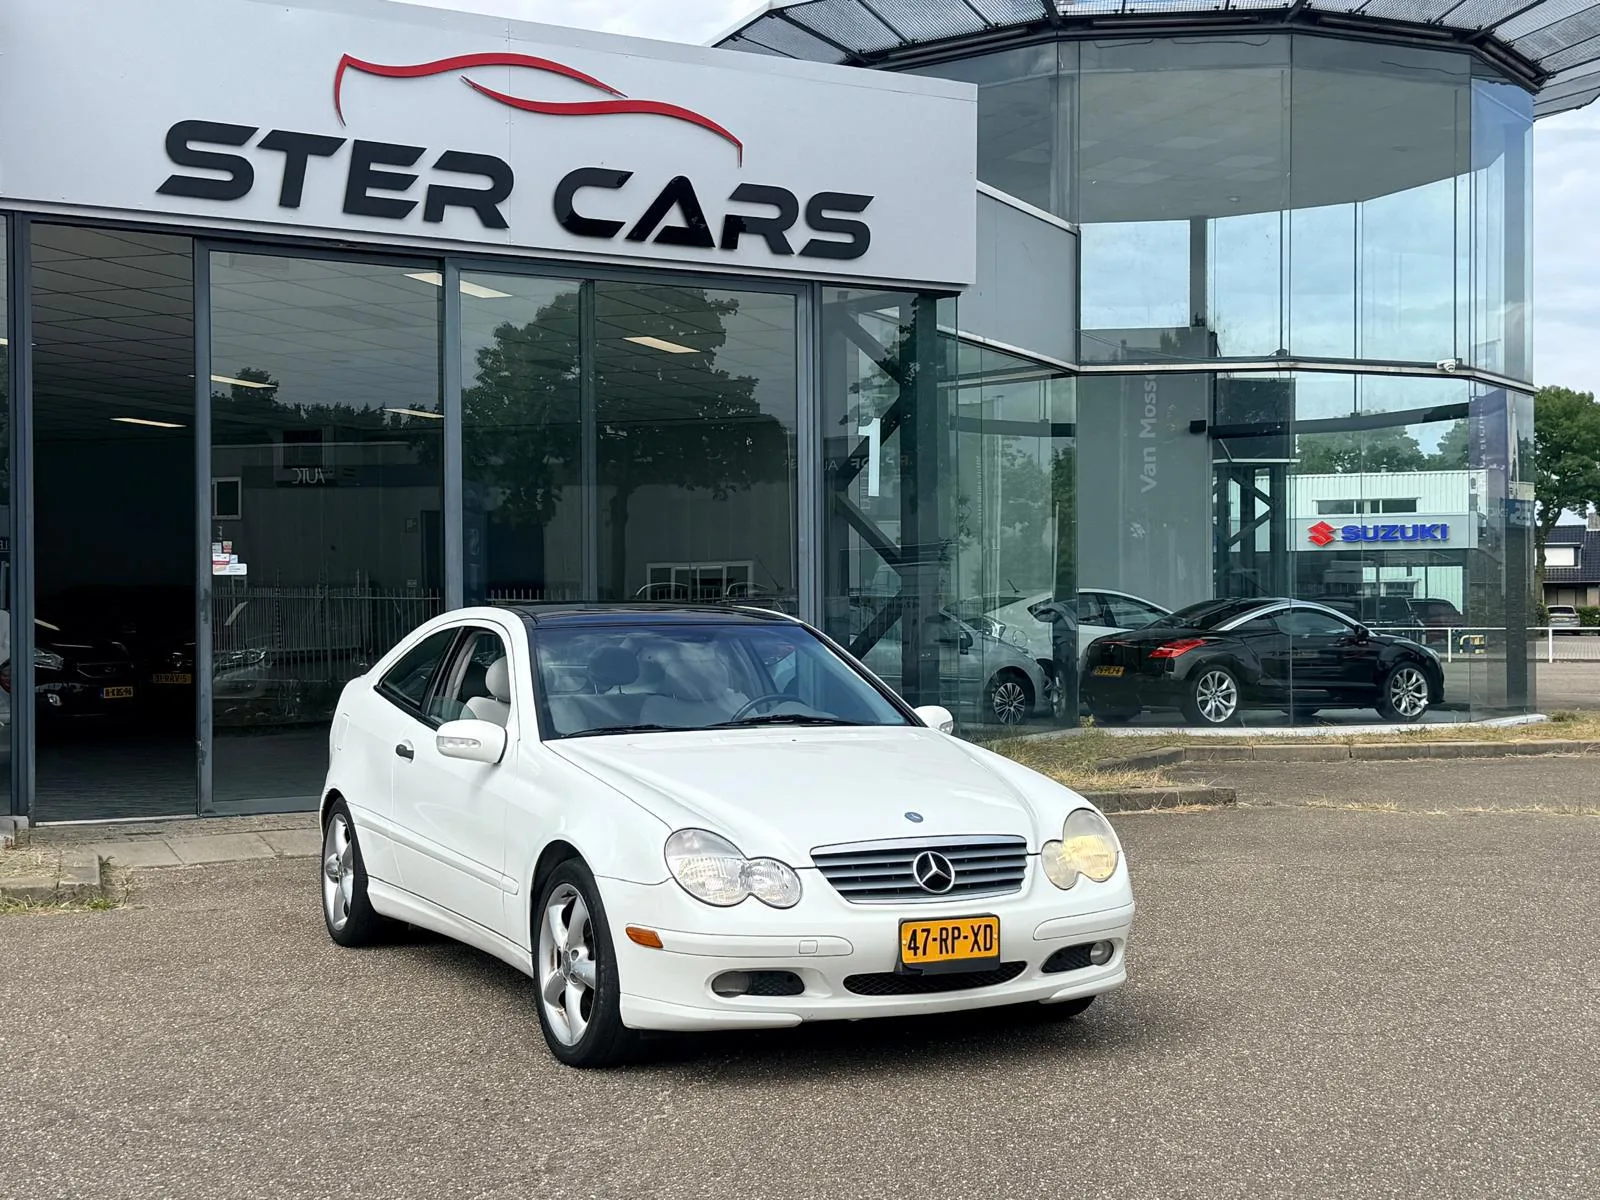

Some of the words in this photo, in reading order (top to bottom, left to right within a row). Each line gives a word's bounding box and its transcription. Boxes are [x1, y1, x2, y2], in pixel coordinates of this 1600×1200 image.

[156, 119, 515, 229] STER
[553, 167, 874, 260] CARS
[1140, 447, 1157, 493] Van
[1341, 523, 1449, 543] SUZUKI
[907, 924, 993, 956] 47-RP-XD
